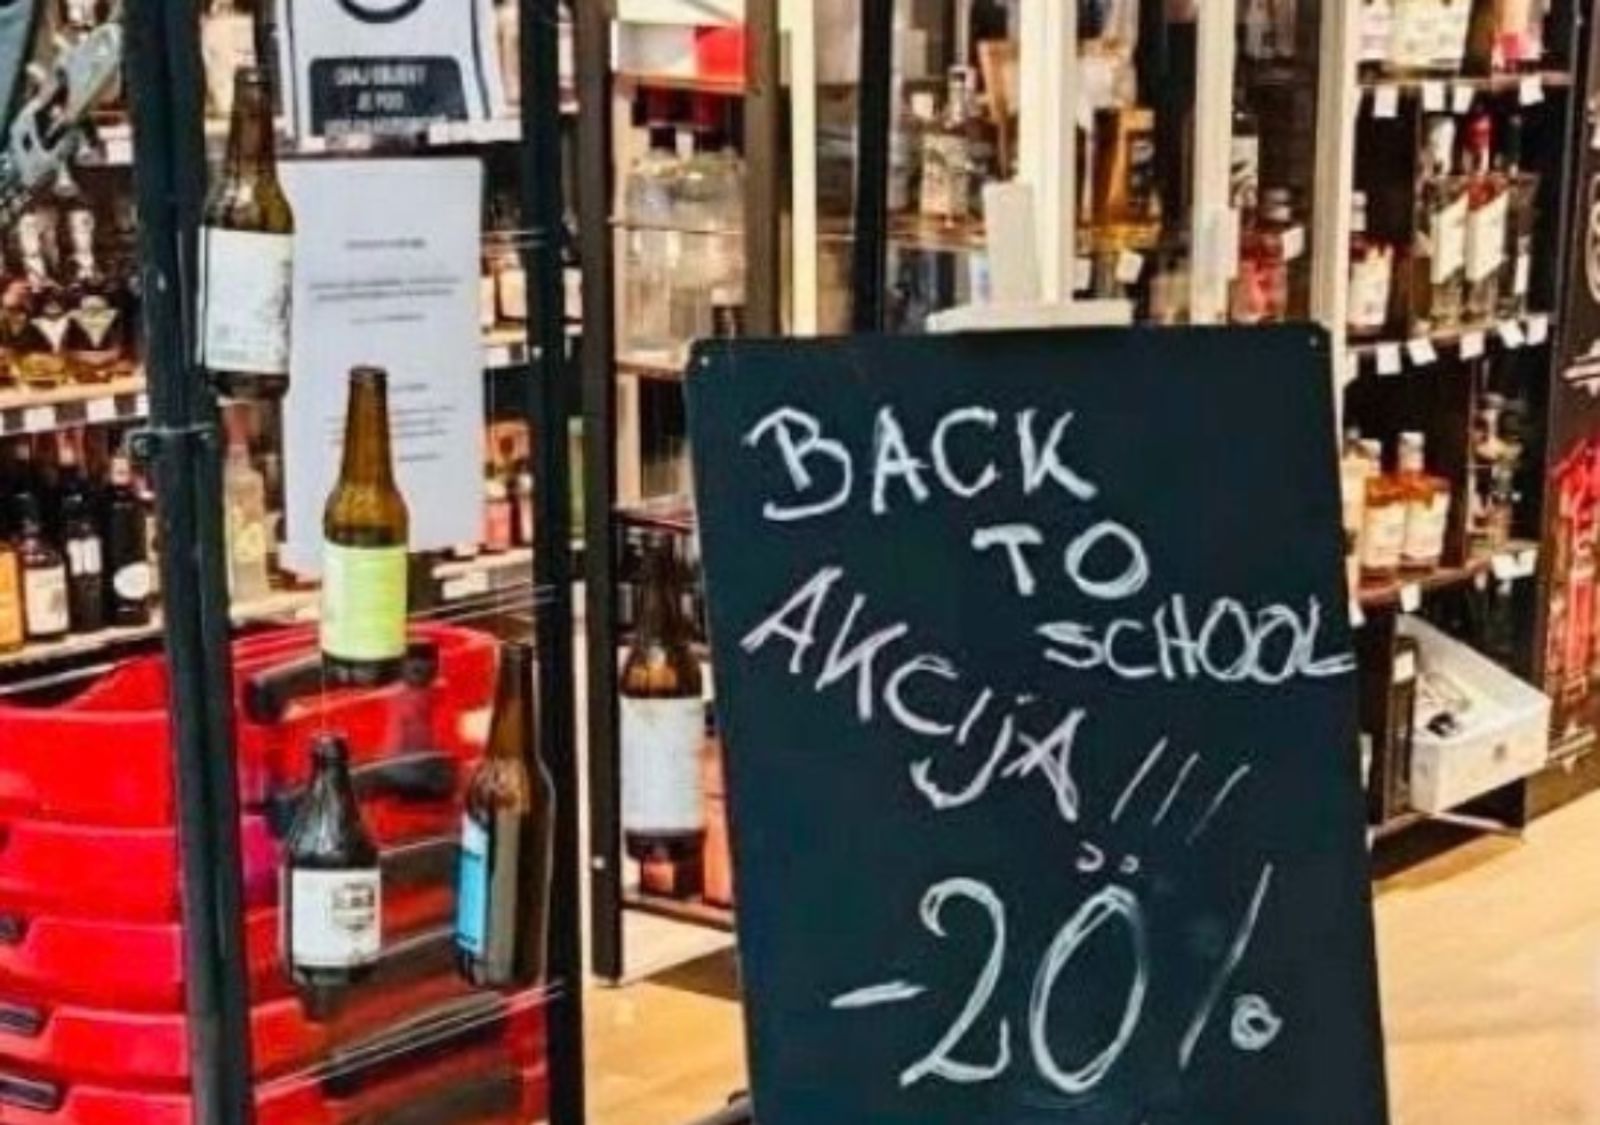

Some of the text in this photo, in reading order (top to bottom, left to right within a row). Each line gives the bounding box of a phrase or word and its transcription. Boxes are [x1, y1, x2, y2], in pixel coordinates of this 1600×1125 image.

[742, 406, 1098, 521] BACK
[971, 520, 1150, 598] TO
[1034, 594, 1357, 684] SCHOOL
